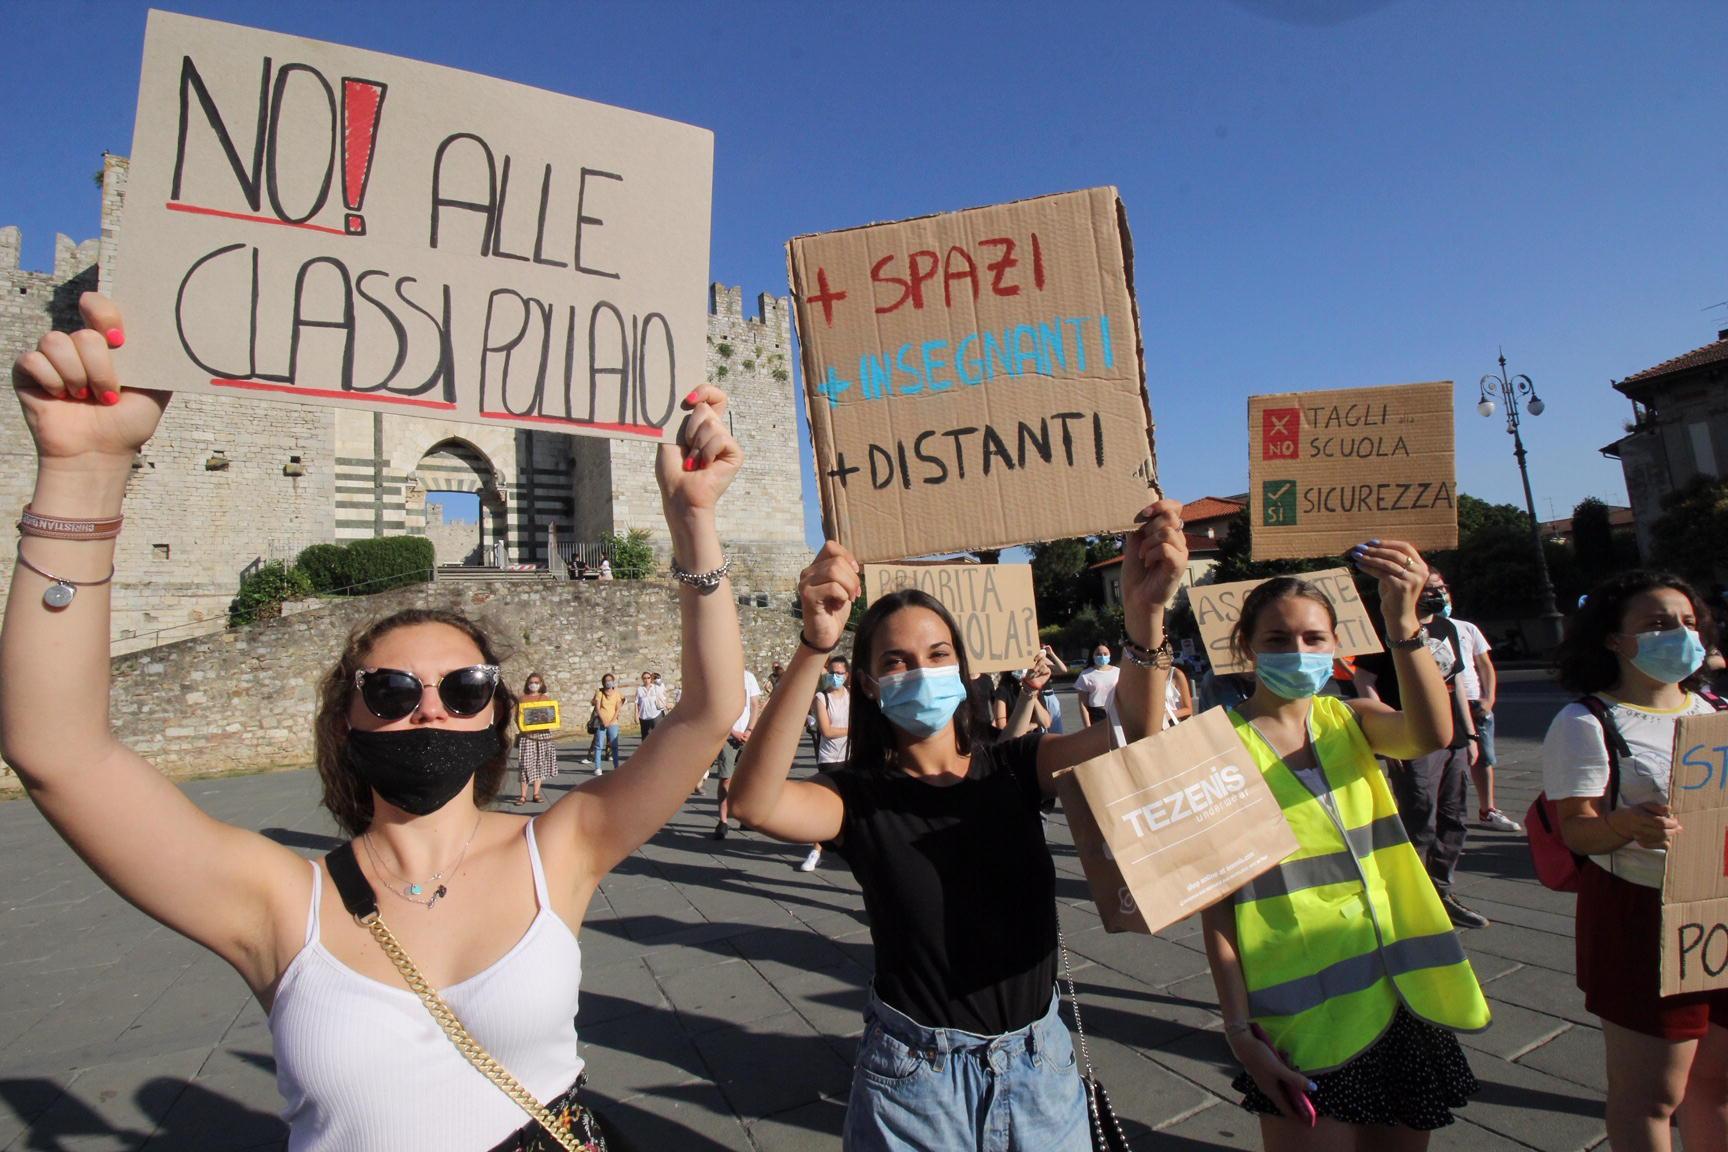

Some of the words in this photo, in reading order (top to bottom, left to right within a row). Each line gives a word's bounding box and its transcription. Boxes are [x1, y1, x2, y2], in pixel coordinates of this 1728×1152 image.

[171, 56, 388, 236] NO!
[430, 133, 623, 279] ALLE
[871, 232, 1046, 314] SPAZI
[175, 243, 457, 403] CLASSI
[480, 288, 676, 430] POLLAIO
[1307, 404, 1388, 429] TAGLI
[1268, 441, 1295, 456] NO
[1310, 436, 1410, 458] SCUOLA
[1303, 481, 1454, 514] SICUREZZA
[957, 607, 1034, 662] OLA?
